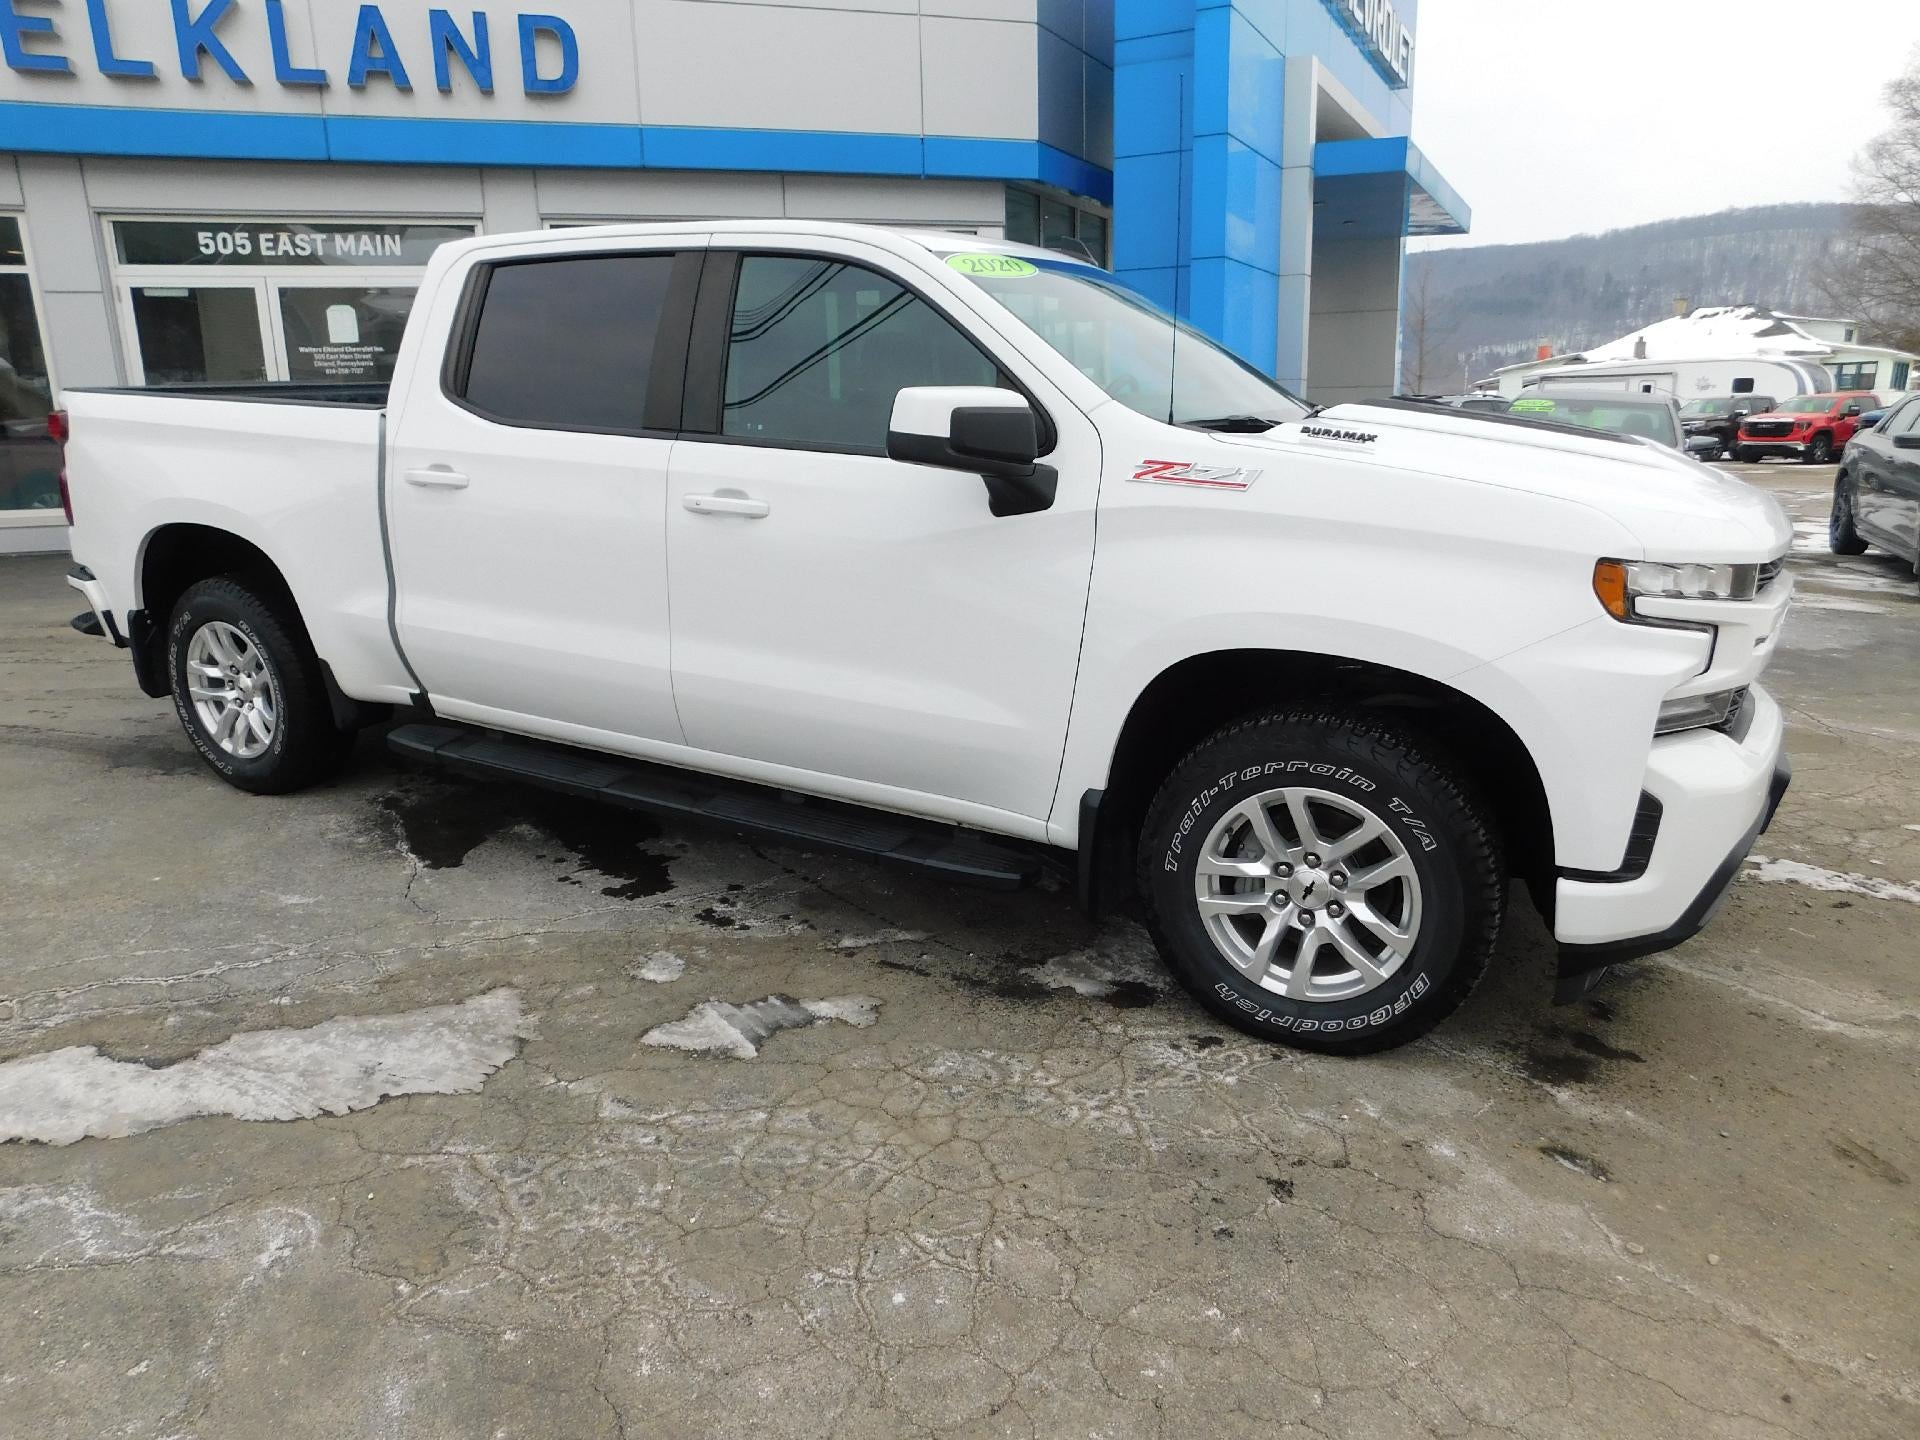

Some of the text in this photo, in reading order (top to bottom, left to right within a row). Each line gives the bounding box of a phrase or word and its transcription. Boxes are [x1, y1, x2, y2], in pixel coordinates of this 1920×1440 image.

[0, 0, 579, 96] ELKLAND
[197, 231, 402, 256] 505 EAST MAIN
[961, 258, 1025, 273] 2020
[1300, 426, 1378, 443] DURAMAX
[1127, 459, 1263, 491] Z71
[1165, 760, 1439, 873] Trail-Terrain T/A
[1214, 972, 1431, 1033] BFGoodrich
